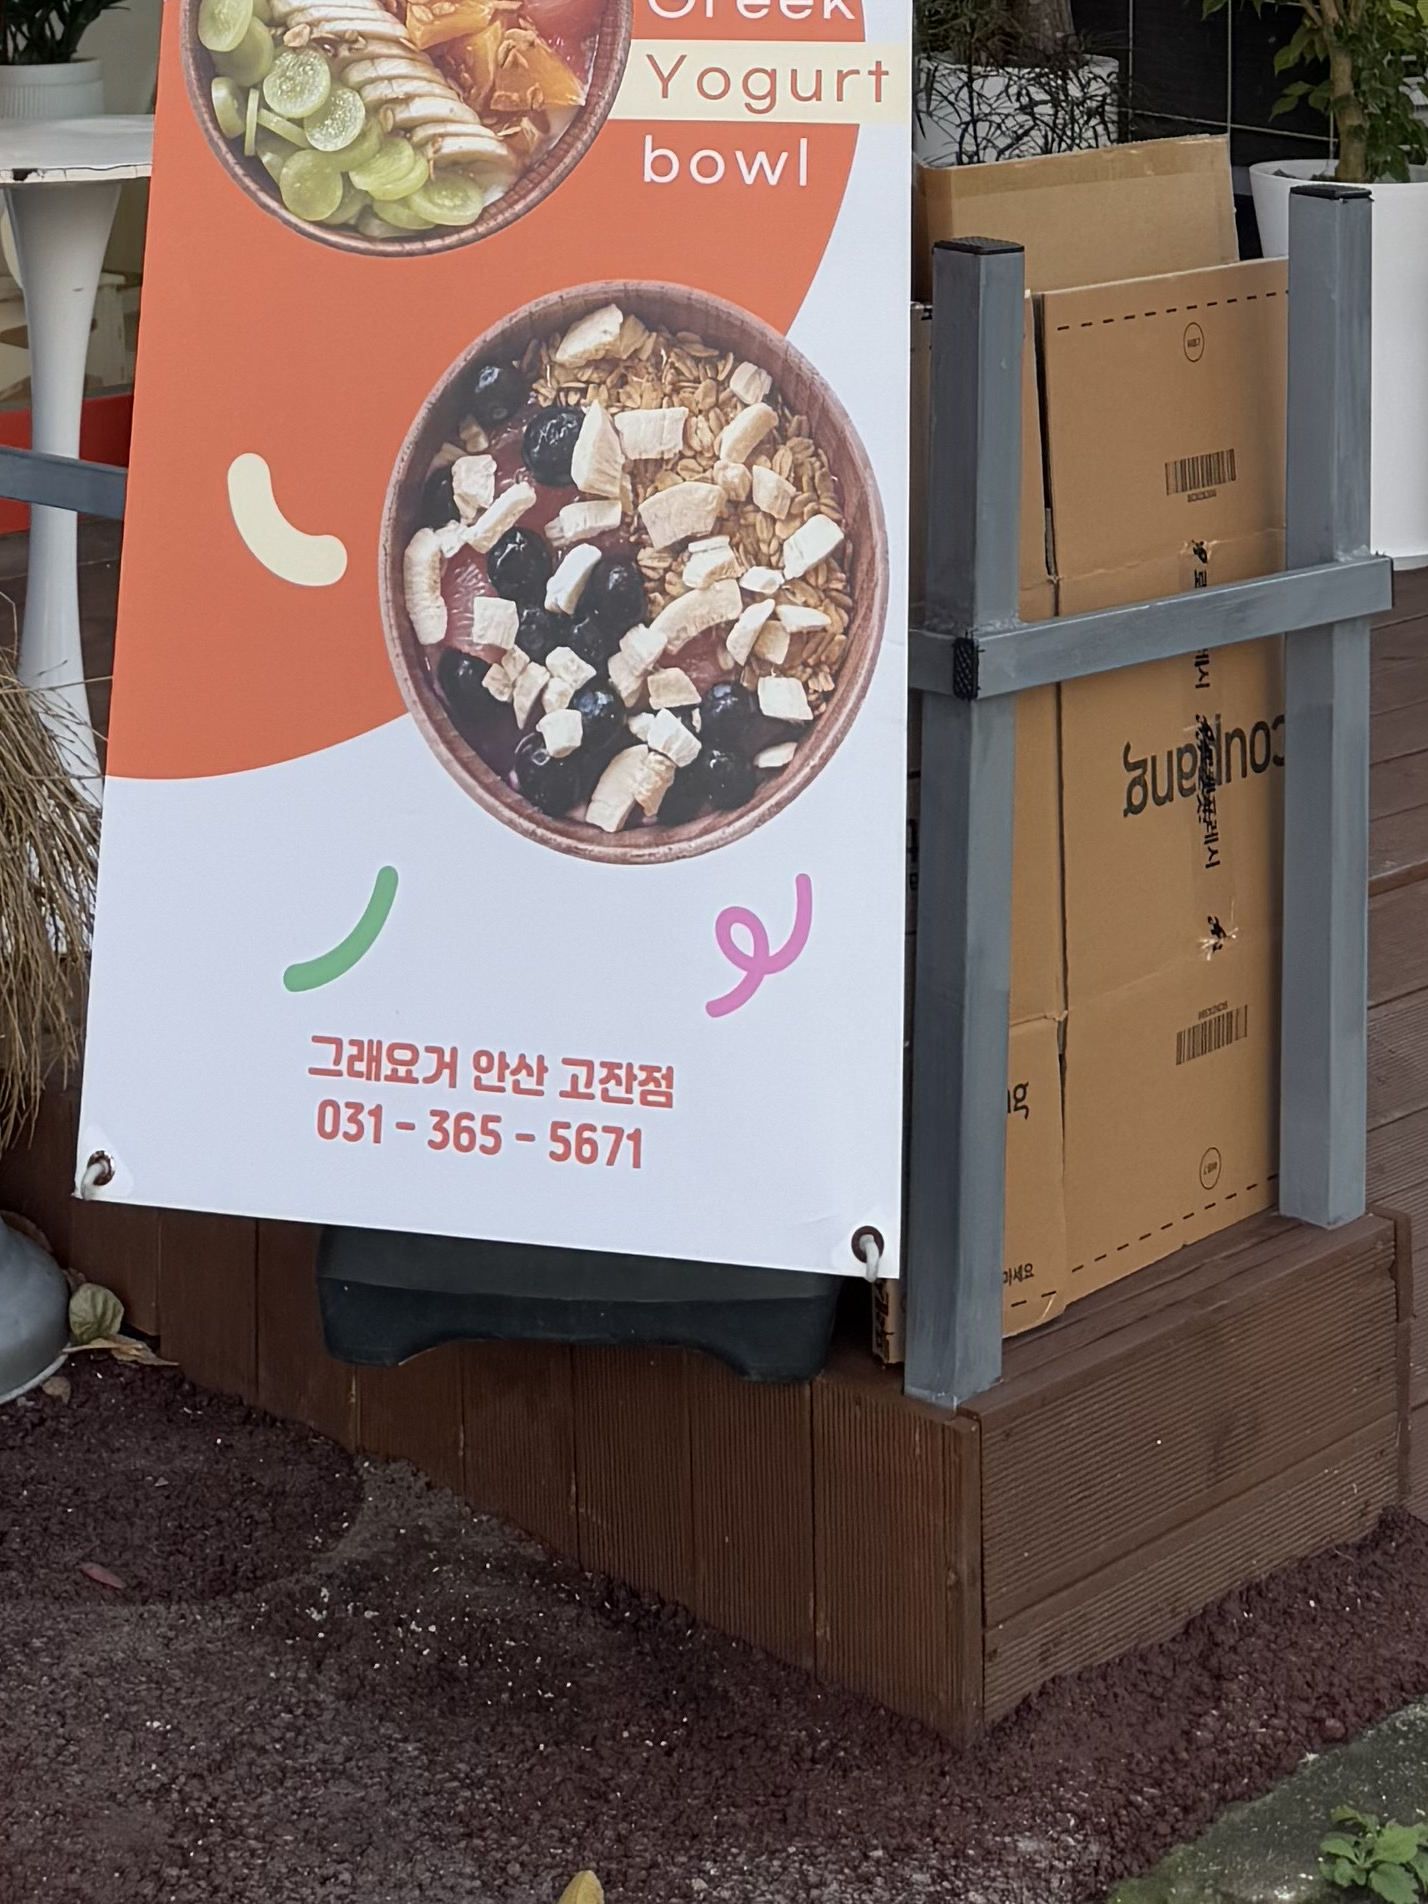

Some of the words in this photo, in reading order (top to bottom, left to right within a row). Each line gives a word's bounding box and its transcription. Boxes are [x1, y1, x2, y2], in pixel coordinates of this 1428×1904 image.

[646, 50, 891, 114] Yogurt
[643, 134, 813, 188] bowl
[308, 1034, 465, 1094] 그래요거
[473, 1046, 550, 1100] 안산
[558, 1055, 677, 1111] 고잔점
